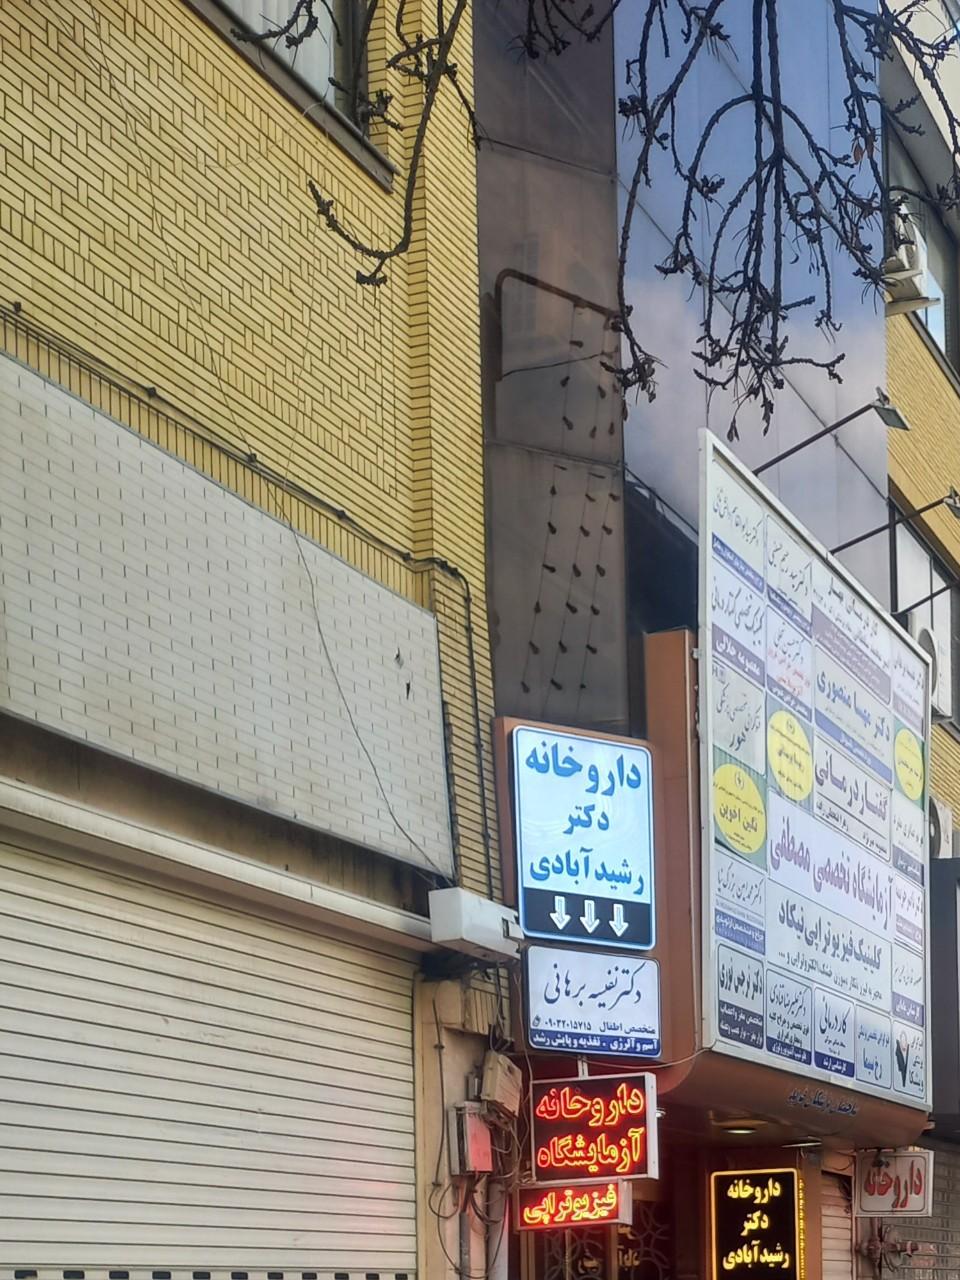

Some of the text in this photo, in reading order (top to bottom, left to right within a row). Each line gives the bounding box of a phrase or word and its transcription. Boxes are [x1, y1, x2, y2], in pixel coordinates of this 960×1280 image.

[525, 742, 642, 796] داروخانه
[562, 803, 610, 836] دکتر
[770, 818, 810, 871] مصطفی
[813, 853, 850, 893] تخصصی
[852, 864, 893, 929] آزمایشگاه
[853, 939, 882, 973] کلینیک
[544, 961, 647, 1011] دکتر نفیسه برهانی
[751, 970, 763, 1000] دکتر
[532, 1032, 551, 1045] رشد
[599, 1020, 623, 1033] اطفال
[623, 1023, 657, 1035] متخصص
[535, 1082, 645, 1128] داروخانه
[537, 1127, 645, 1174] آزمایشگاه
[522, 1183, 618, 1225] فیزیوتراپی
[726, 1176, 782, 1204] داروخانه
[863, 1159, 923, 1209] داروخانه
[740, 1210, 770, 1237] دکتر
